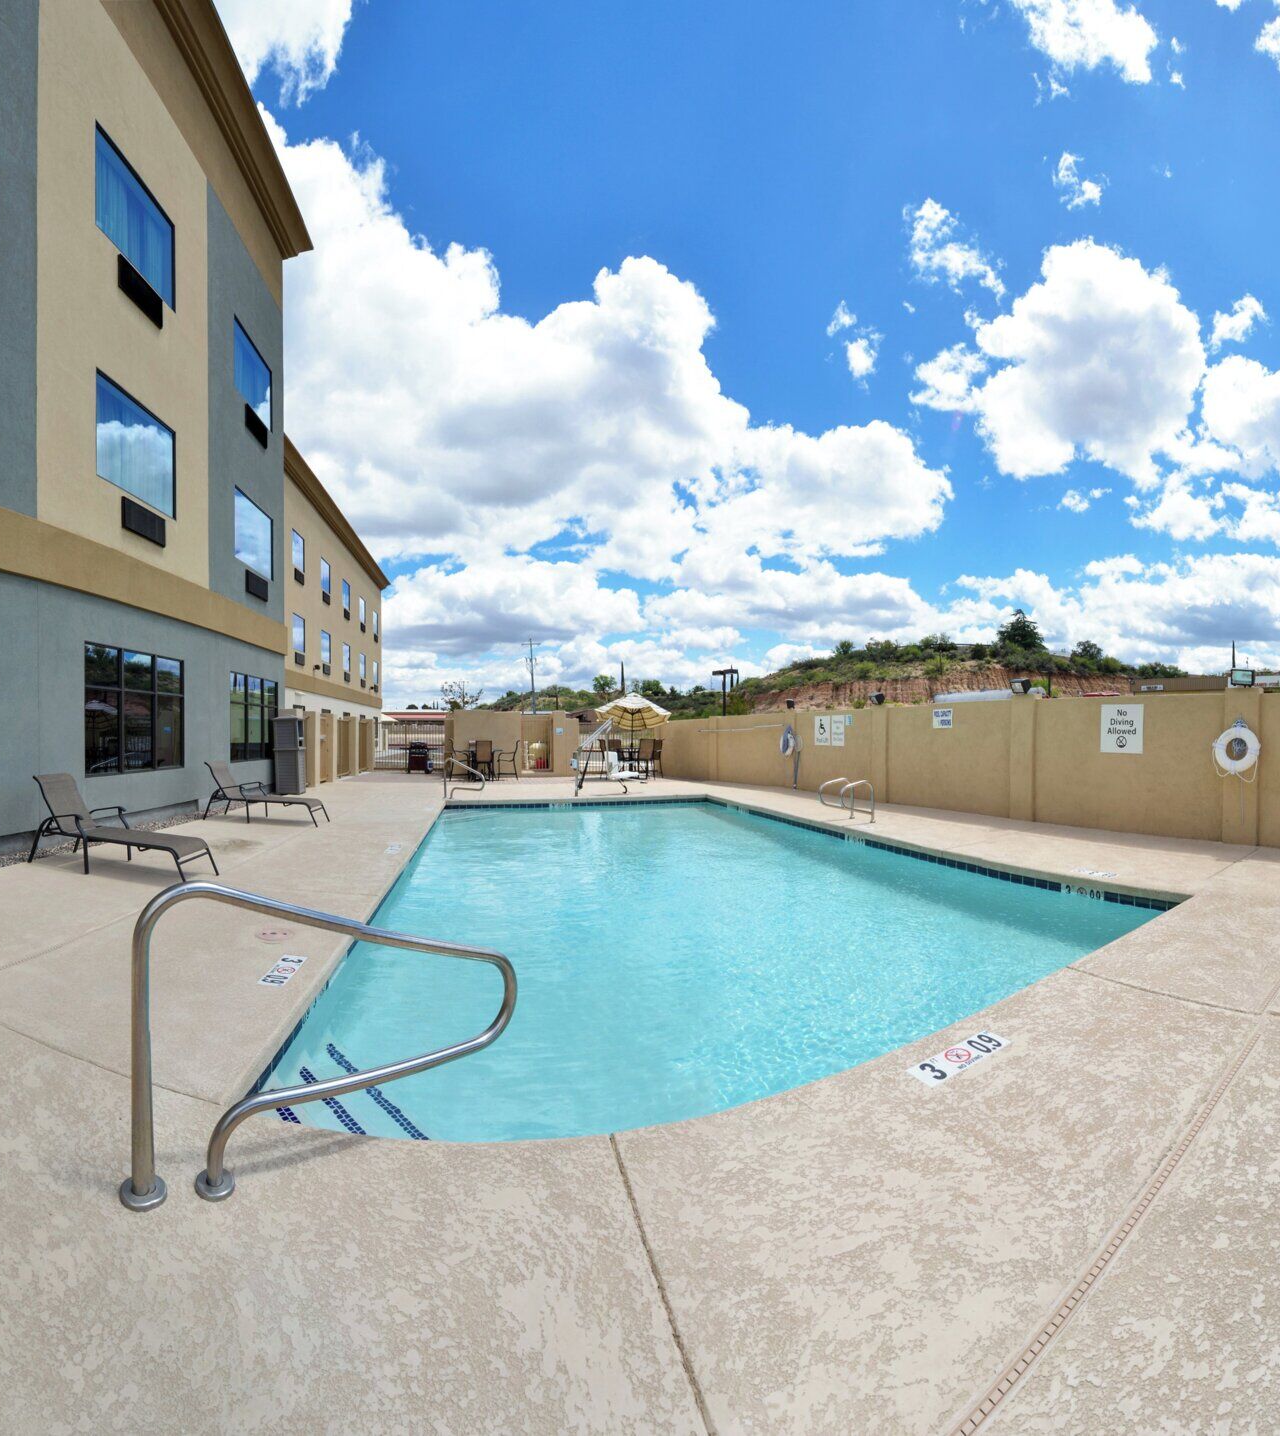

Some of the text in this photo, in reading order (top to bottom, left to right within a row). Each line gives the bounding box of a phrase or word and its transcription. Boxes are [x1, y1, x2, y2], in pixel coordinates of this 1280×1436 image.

[1116, 709, 1128, 717] No
[1110, 718, 1134, 727] Diving
[1106, 727, 1137, 735] Allowed
[966, 1034, 1002, 1054] 0.9
[919, 1062, 948, 1081] 3
